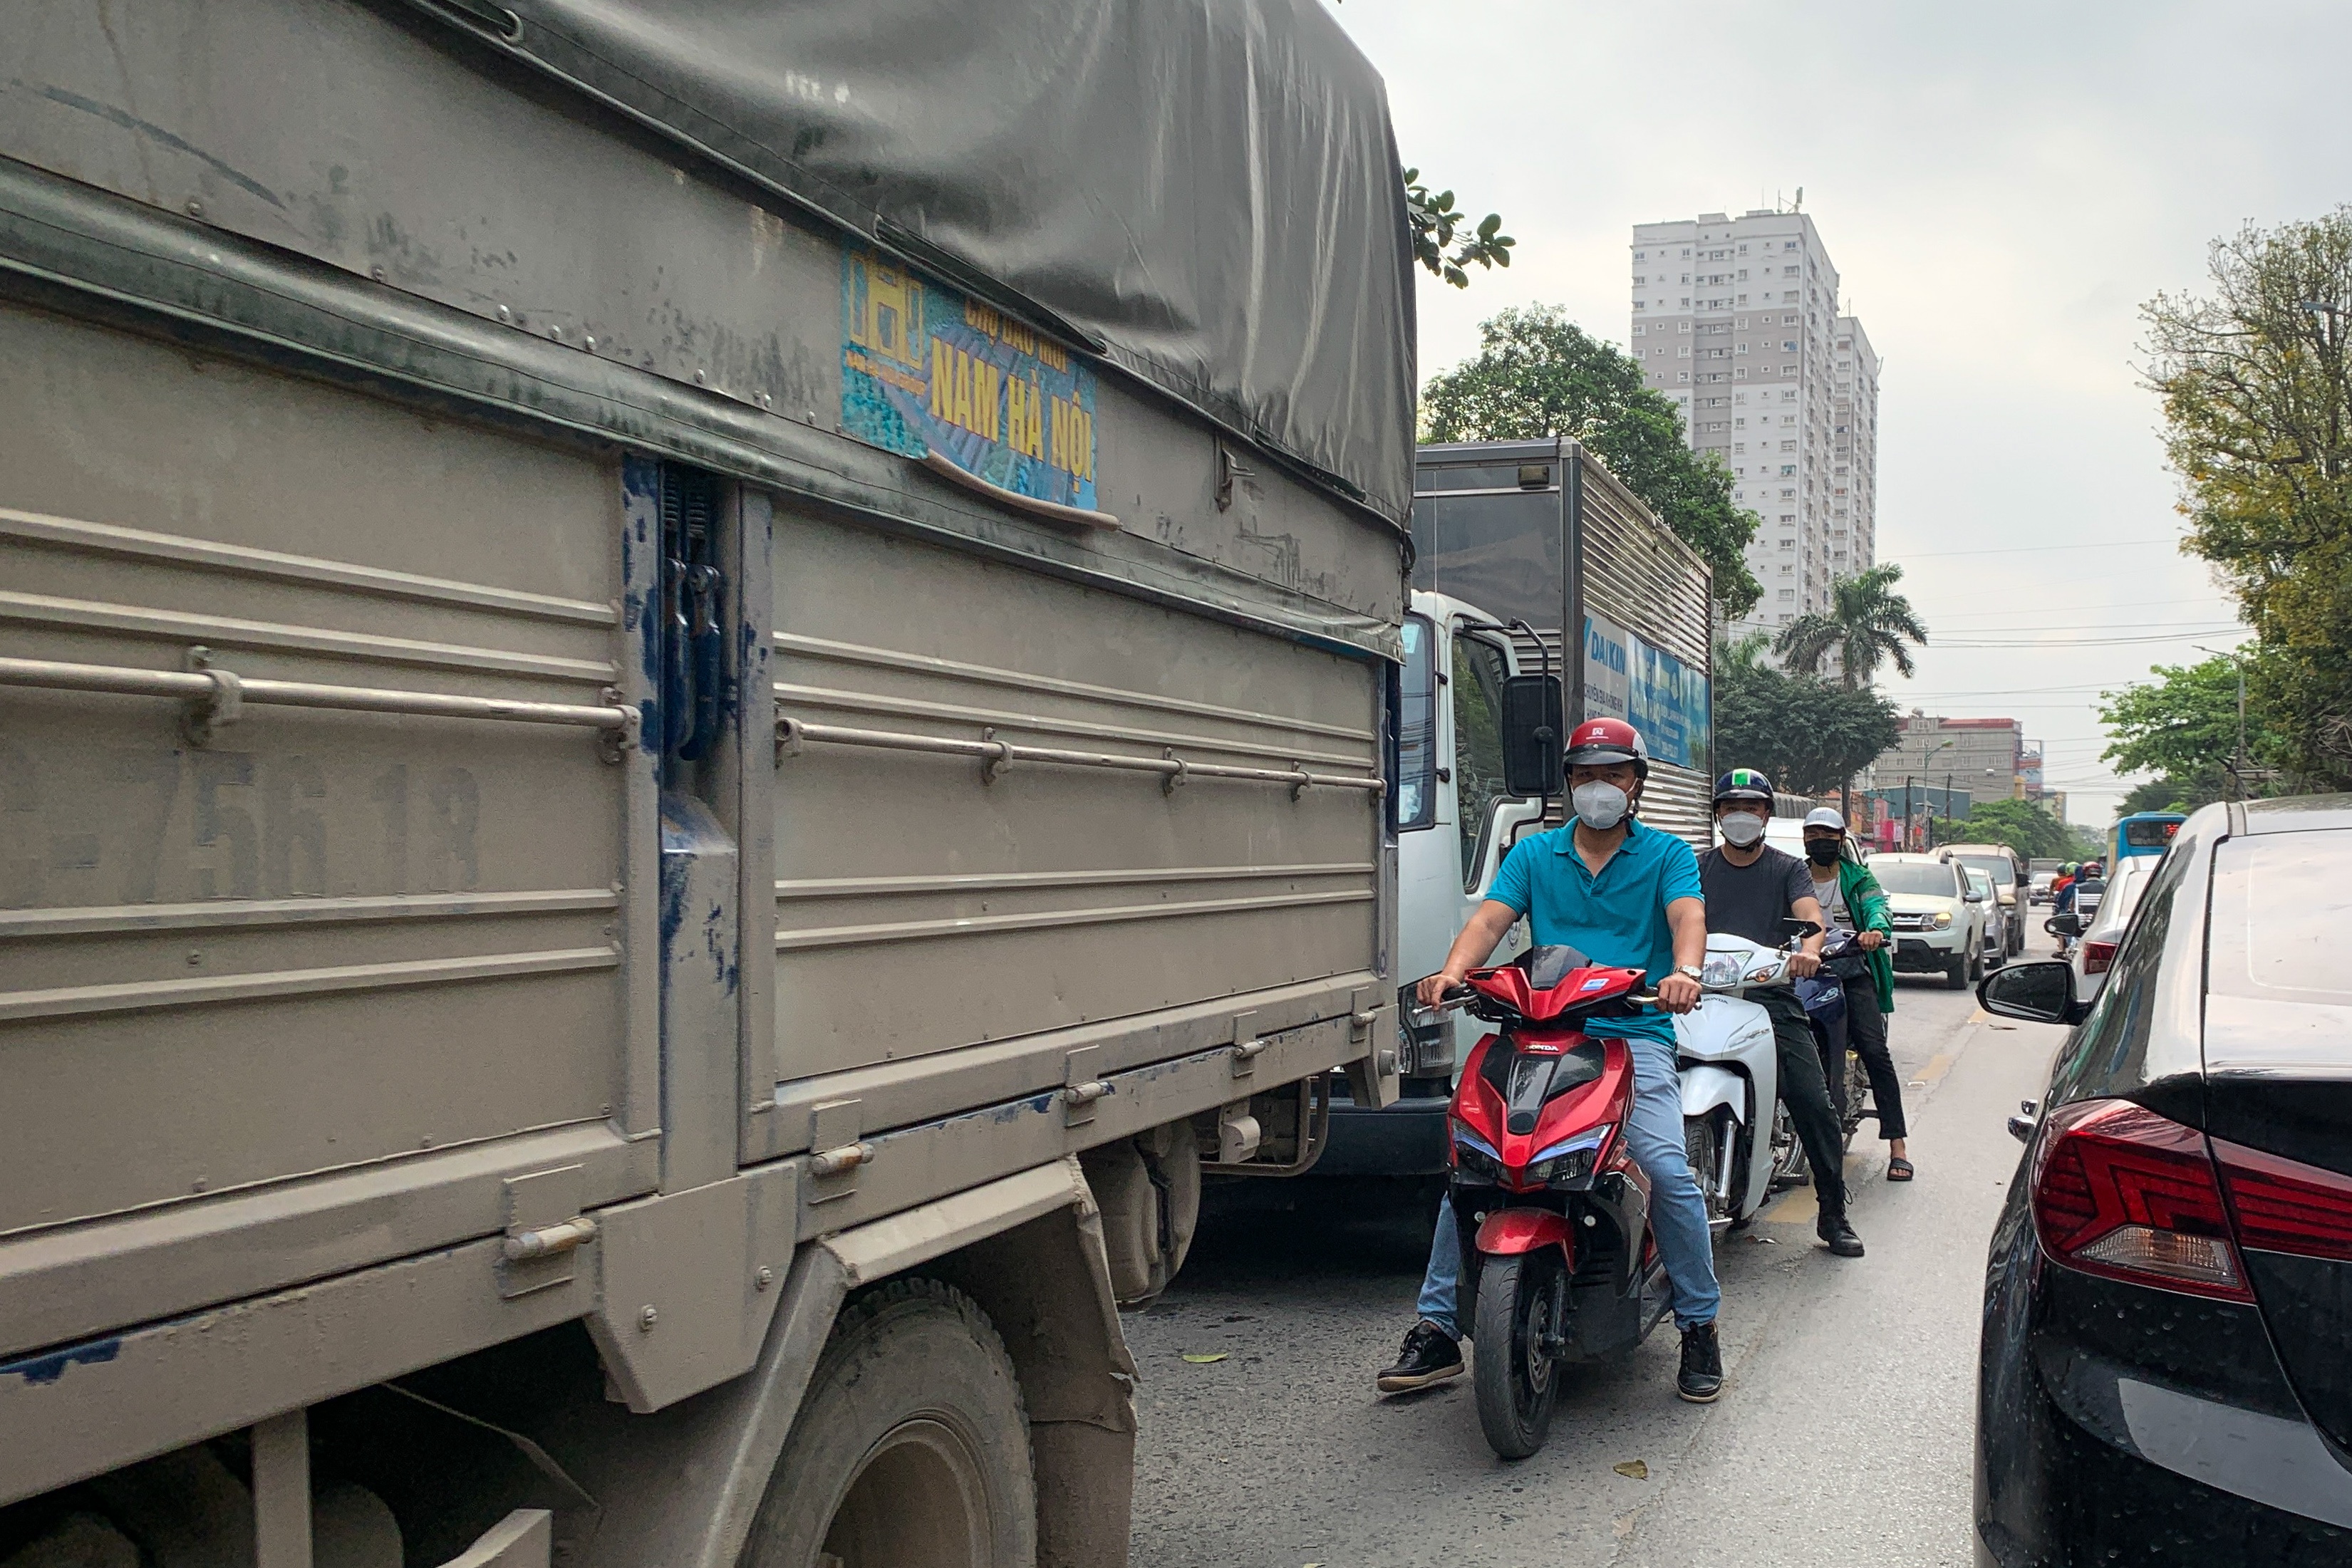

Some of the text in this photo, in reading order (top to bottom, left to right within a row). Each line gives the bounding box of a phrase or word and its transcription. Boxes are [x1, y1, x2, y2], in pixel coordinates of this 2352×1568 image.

[931, 335, 998, 444] NAM
[1007, 368, 1043, 463] HÀ
[1051, 390, 1092, 493] NỘI
[1591, 630, 1626, 675] DAIKIN
